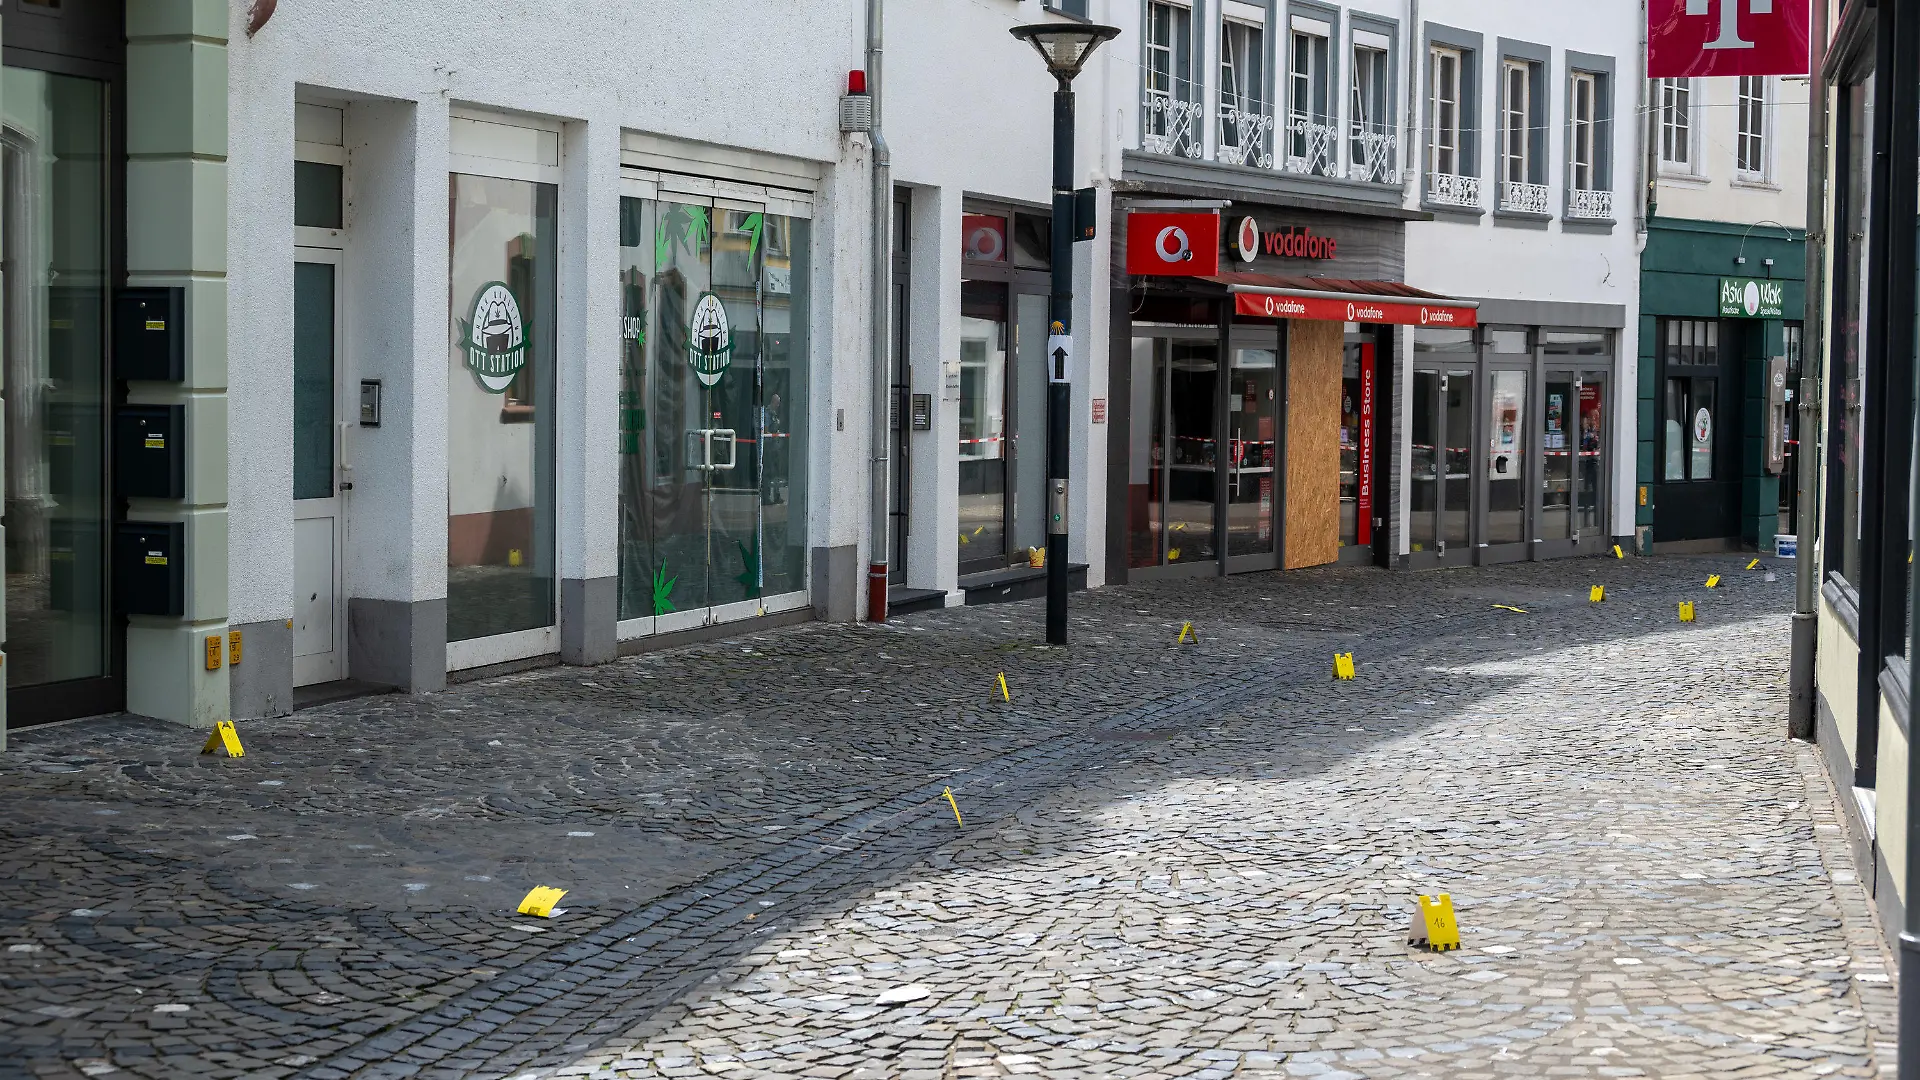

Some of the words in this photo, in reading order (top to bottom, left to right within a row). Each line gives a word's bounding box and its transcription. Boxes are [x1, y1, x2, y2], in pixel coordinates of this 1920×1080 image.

[1686, 0, 1772, 49] T
[1264, 225, 1337, 259] vodafone
[1722, 280, 1743, 304] Asia
[1760, 283, 1781, 305] Wok
[1276, 300, 1305, 314] vodafone
[1356, 306, 1383, 318] vodafone
[1430, 310, 1454, 322] vodafone
[623, 316, 641, 339] SHOP
[469, 347, 486, 371] OTT
[490, 347, 524, 373] STATION
[689, 348, 702, 369] OTT
[1363, 369, 1371, 415] Store
[1361, 418, 1371, 496] Business
[1434, 918, 1446, 928] 16
